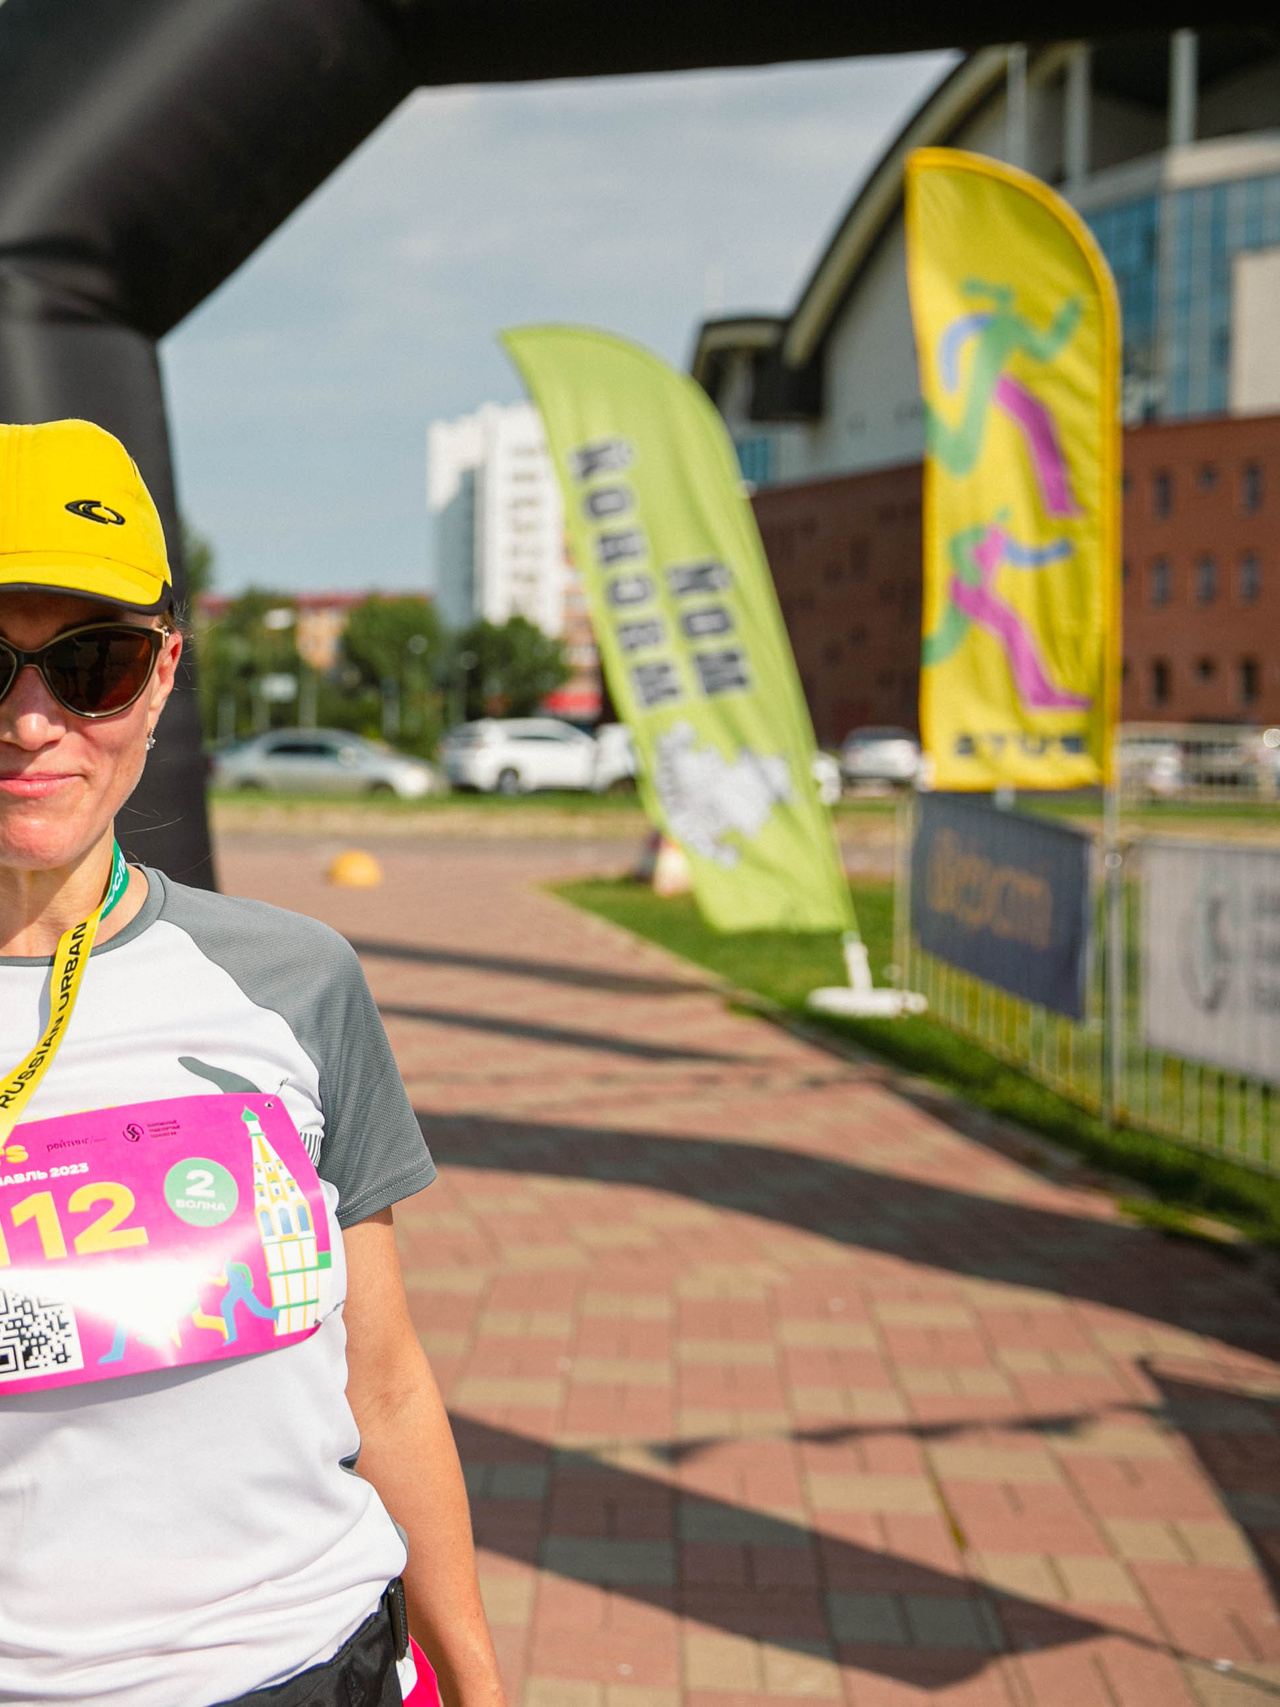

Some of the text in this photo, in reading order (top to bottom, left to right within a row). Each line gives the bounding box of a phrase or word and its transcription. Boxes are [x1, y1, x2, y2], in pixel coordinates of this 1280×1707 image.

[58, 922, 88, 1012] URBAN
[49, 1162, 90, 1179] 2023
[185, 1168, 216, 1198] 2
[175, 1198, 227, 1212] ВОЛНА
